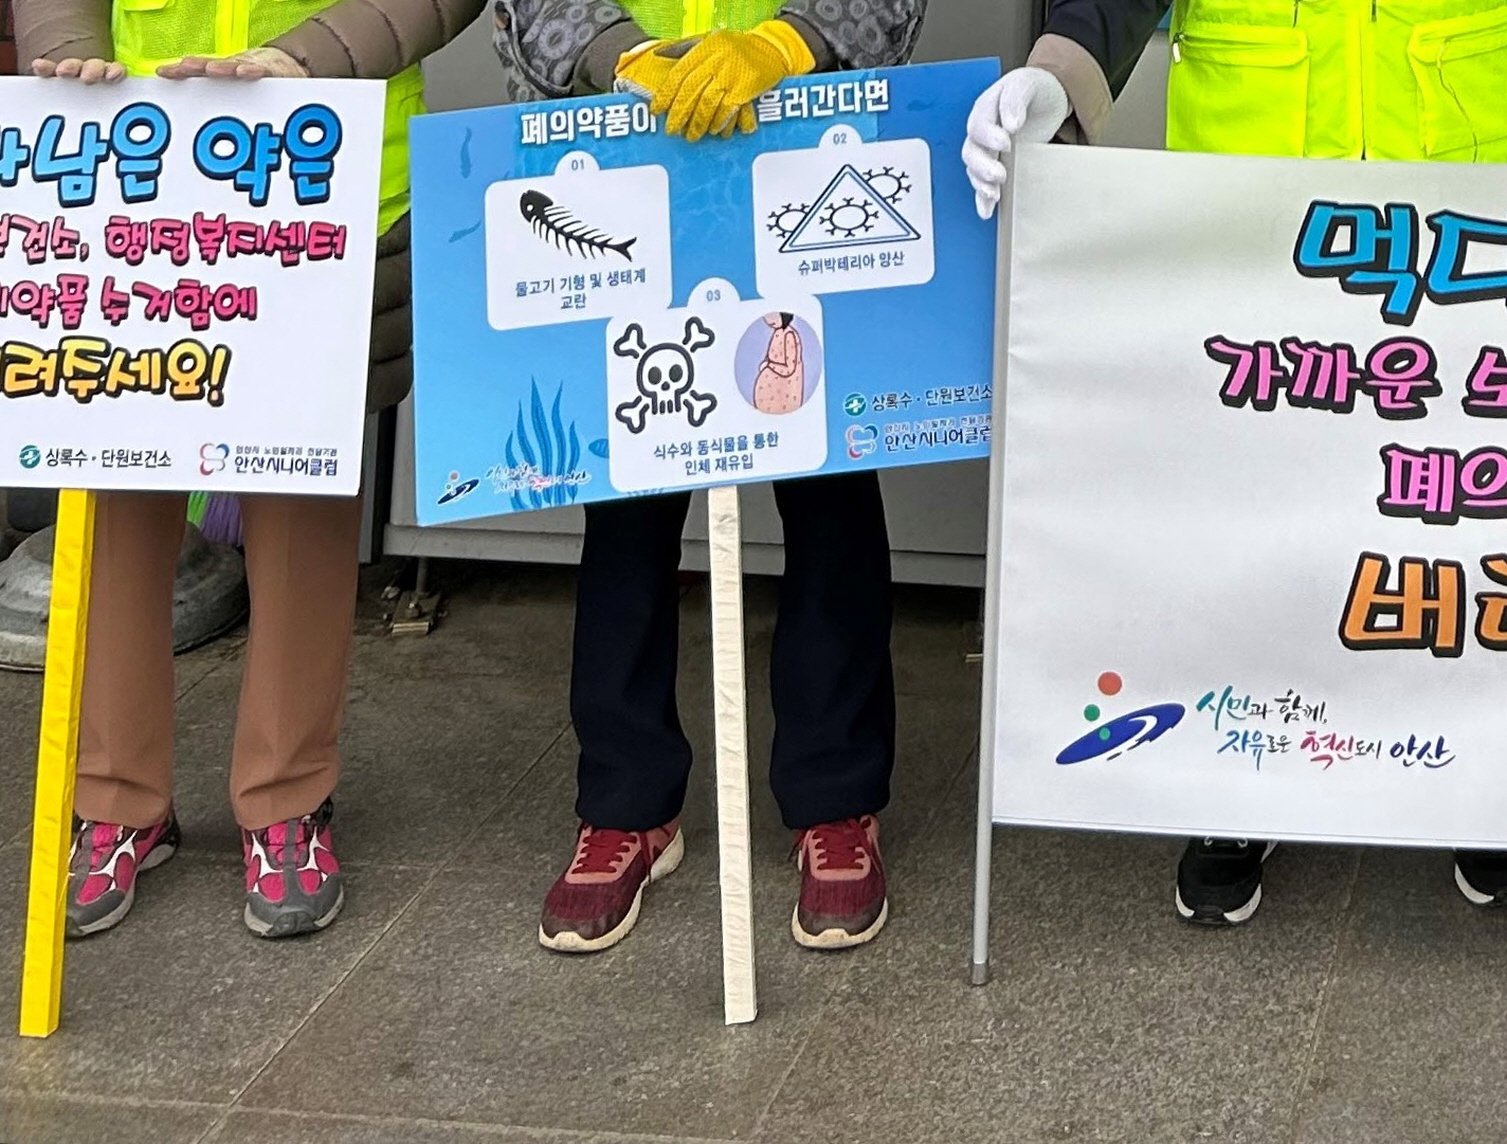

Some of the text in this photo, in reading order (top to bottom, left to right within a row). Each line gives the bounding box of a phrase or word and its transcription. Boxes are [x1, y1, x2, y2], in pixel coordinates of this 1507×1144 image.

[832, 132, 848, 146] 02
[193, 103, 344, 207] 약은
[571, 158, 586, 172] 01
[105, 212, 348, 268] 행정복지센터
[798, 253, 876, 276] 슈퍼박테리아
[515, 267, 646, 298] 물고기 기형 및 생태계
[705, 289, 722, 303] 03
[0, 273, 259, 332] 약품 수거함에
[560, 292, 586, 310] 교란
[1203, 337, 1444, 418] 가까운
[653, 431, 779, 460] 식수와 동식물을 통한
[234, 456, 338, 476] 안산시니어클럽
[685, 453, 754, 476] 인체 재유입
[1195, 685, 1329, 731] 시민과 함께,
[1217, 729, 1456, 771] 자유로운 혁신도시 안산
